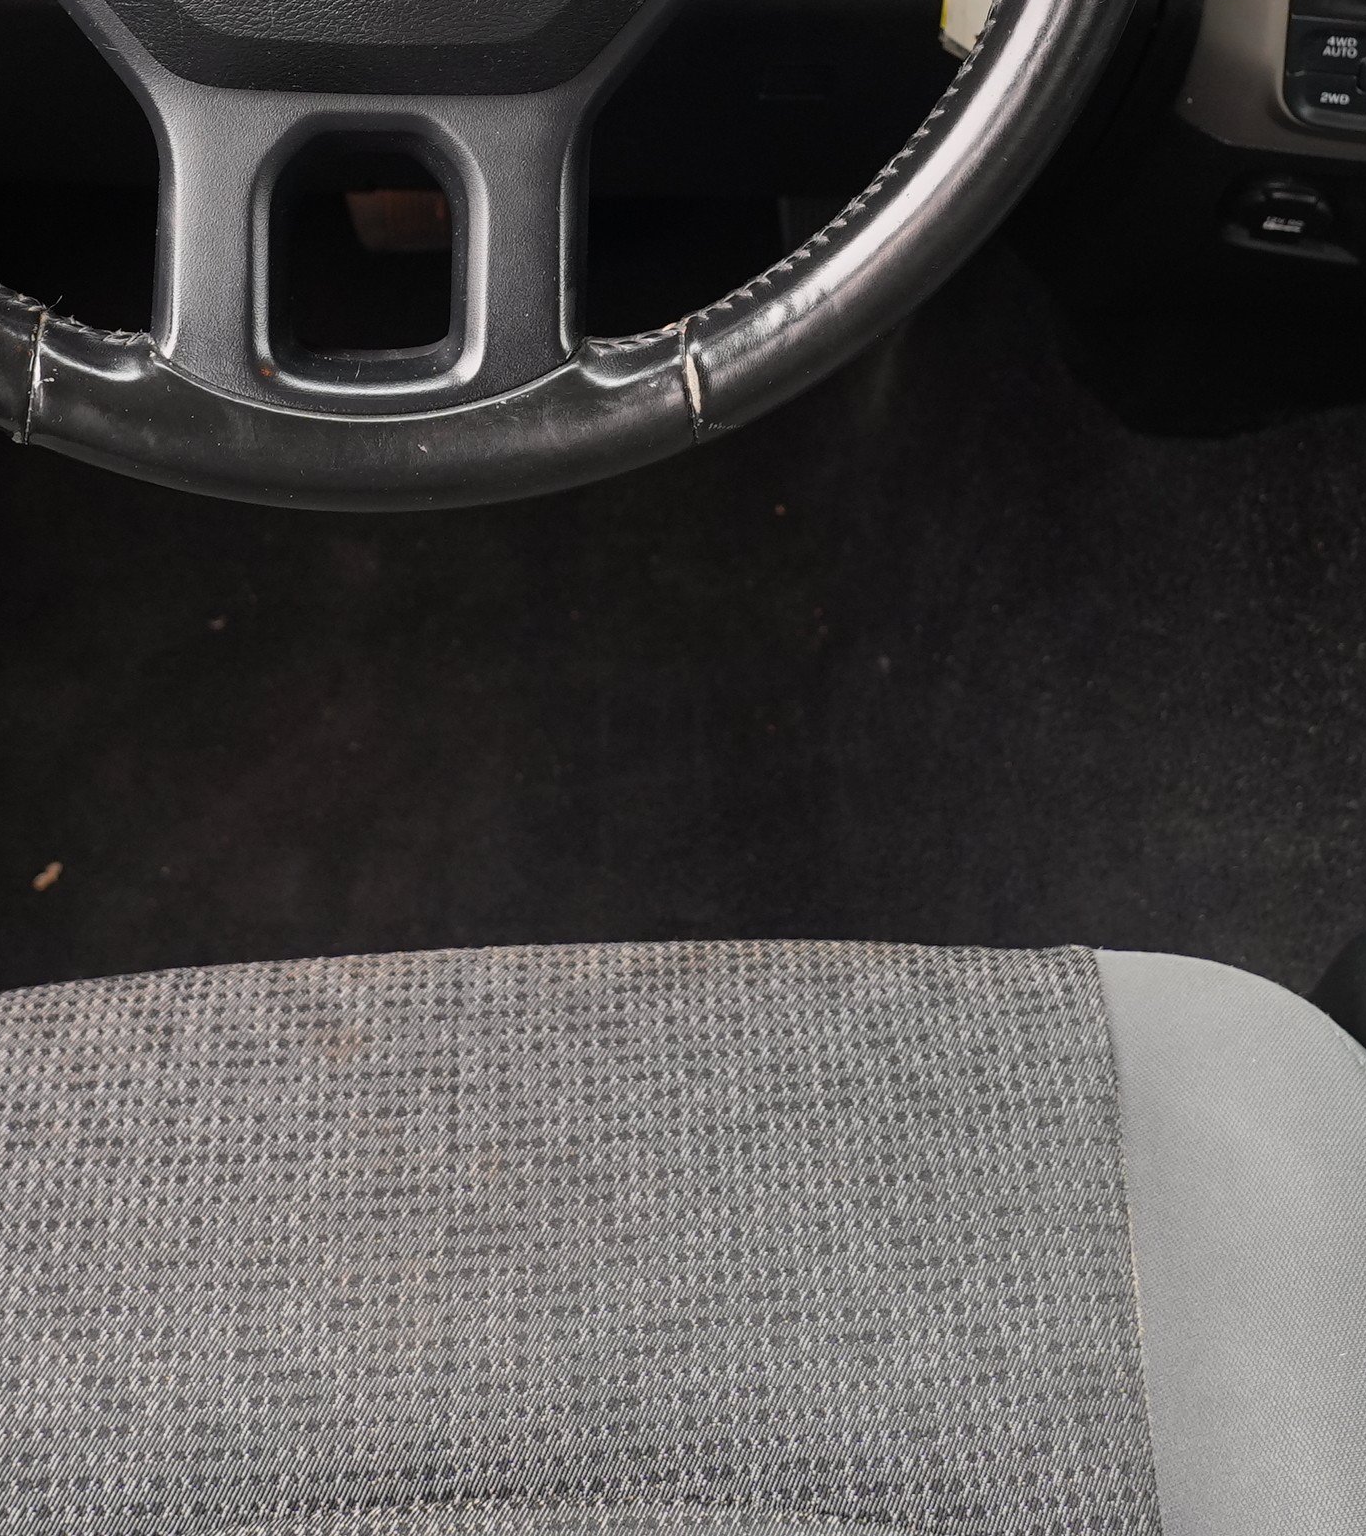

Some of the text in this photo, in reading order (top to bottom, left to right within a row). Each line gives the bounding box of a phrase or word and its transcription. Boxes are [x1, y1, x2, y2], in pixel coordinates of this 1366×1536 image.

[1327, 35, 1358, 48] 4WD
[1322, 46, 1358, 59] AUTO
[1319, 91, 1351, 105] 2WD
